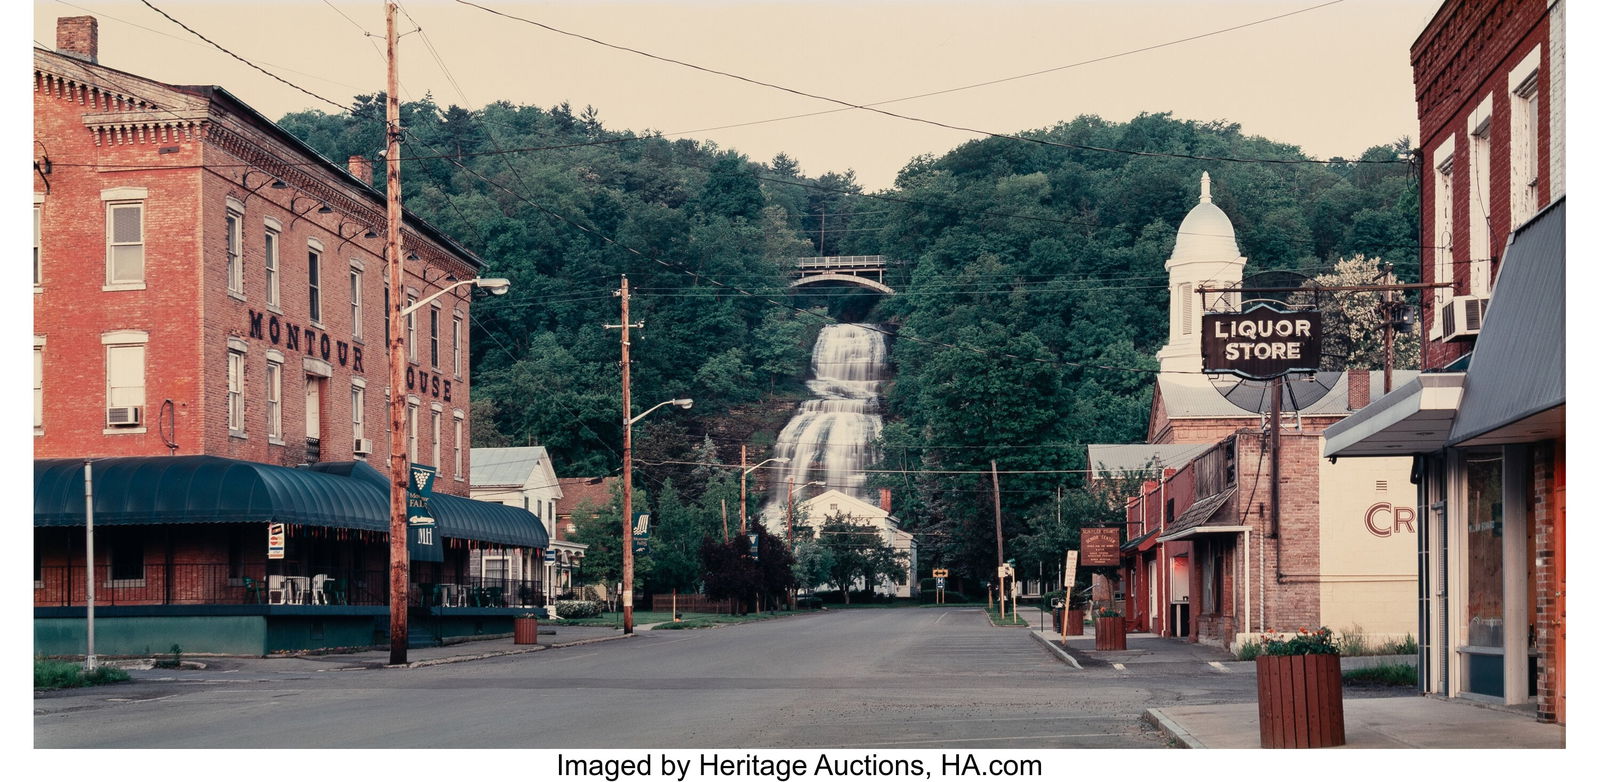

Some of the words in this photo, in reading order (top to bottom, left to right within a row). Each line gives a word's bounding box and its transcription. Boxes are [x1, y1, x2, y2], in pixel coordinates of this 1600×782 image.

[1215, 319, 1311, 339] LIQUOR
[249, 309, 364, 373] MONTOUR
[406, 366, 452, 402] OUSE
[1225, 342, 1301, 360] STORE
[418, 528, 433, 545] MH
